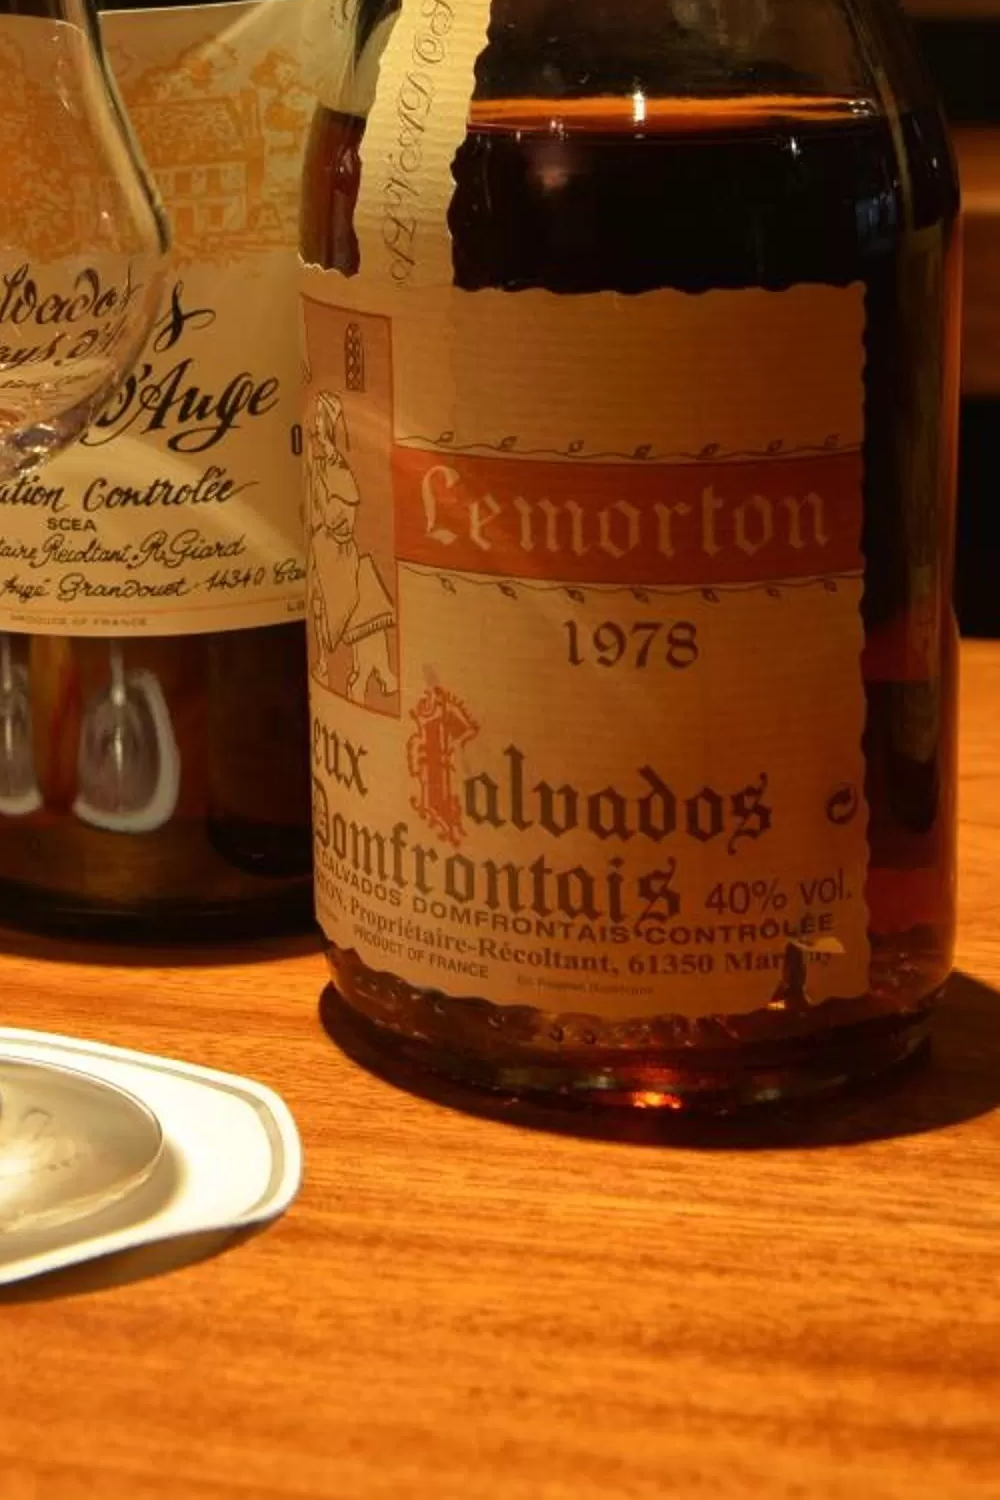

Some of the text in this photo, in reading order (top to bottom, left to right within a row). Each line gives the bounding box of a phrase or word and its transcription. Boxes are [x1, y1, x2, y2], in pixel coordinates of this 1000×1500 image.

[47, 517, 97, 532] SCEA
[420, 465, 831, 559] Lemorton
[563, 620, 699, 670] 1978
[406, 684, 773, 855] Calvados
[704, 879, 789, 916] 40%
[412, 895, 631, 946] DOMFRONTAIS
[428, 953, 489, 979] FRANCE
[628, 952, 714, 976] 61350
